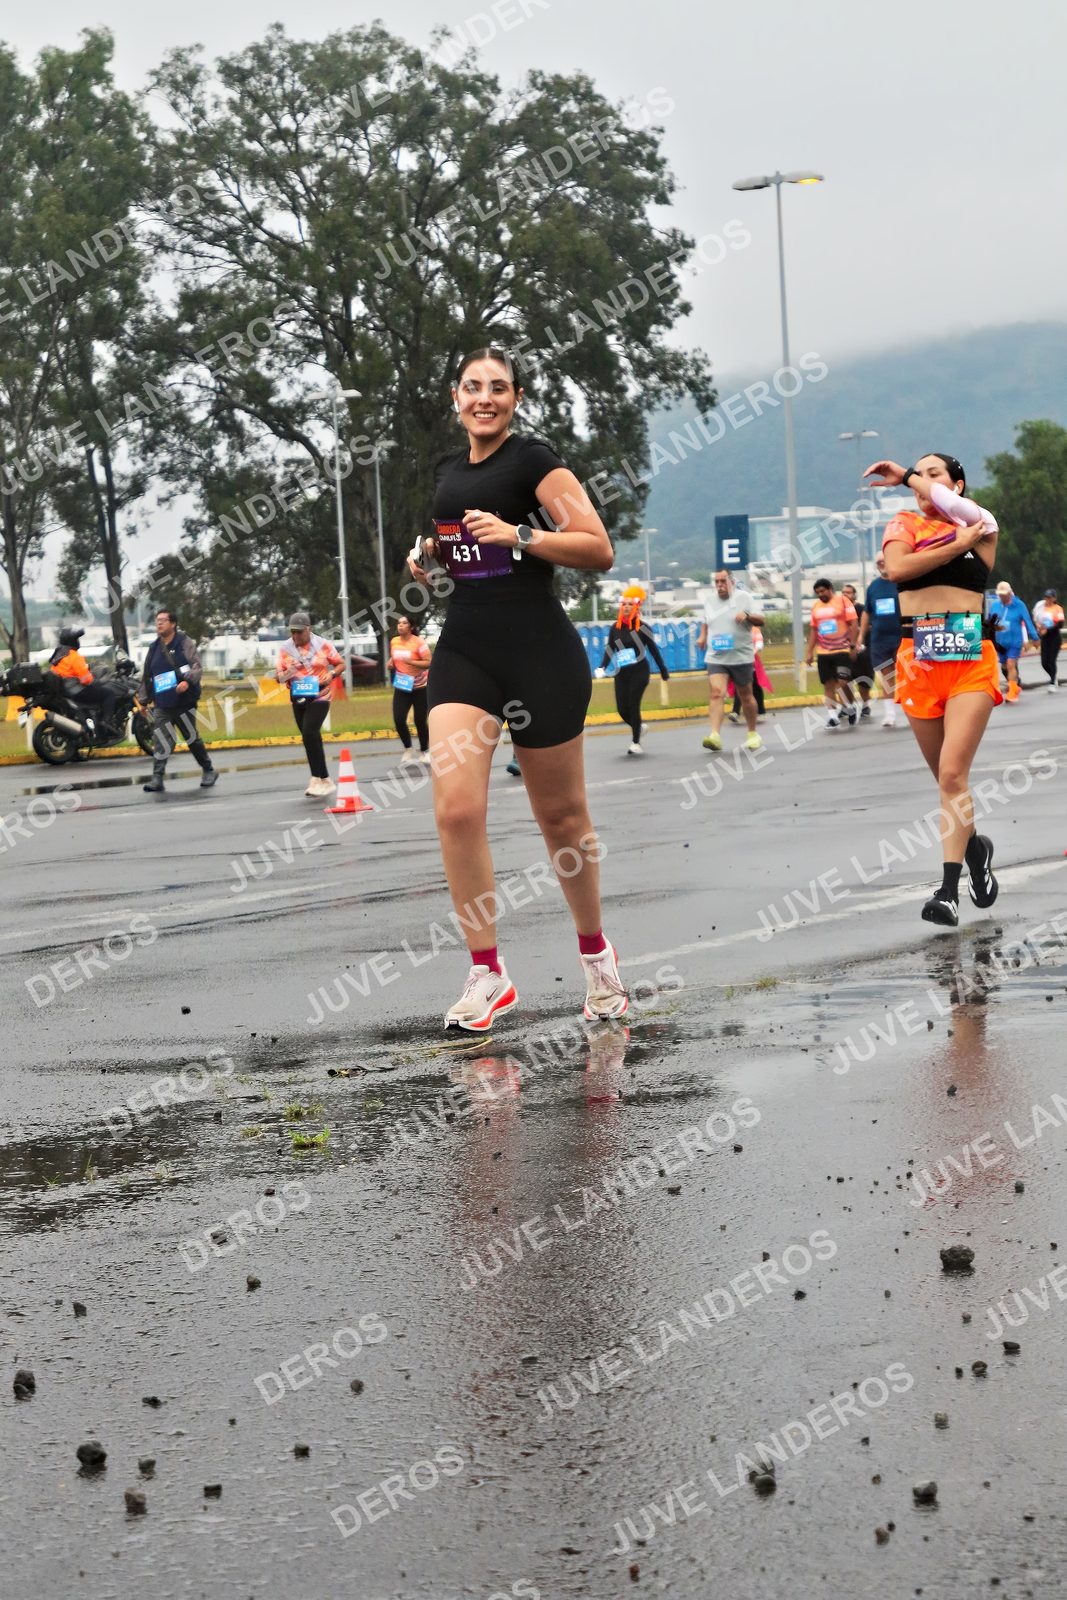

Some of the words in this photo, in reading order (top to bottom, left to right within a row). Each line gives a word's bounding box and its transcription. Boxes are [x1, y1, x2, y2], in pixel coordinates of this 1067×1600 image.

[452, 544, 481, 562] 431
[722, 538, 741, 564] E
[924, 633, 965, 648] 1326
